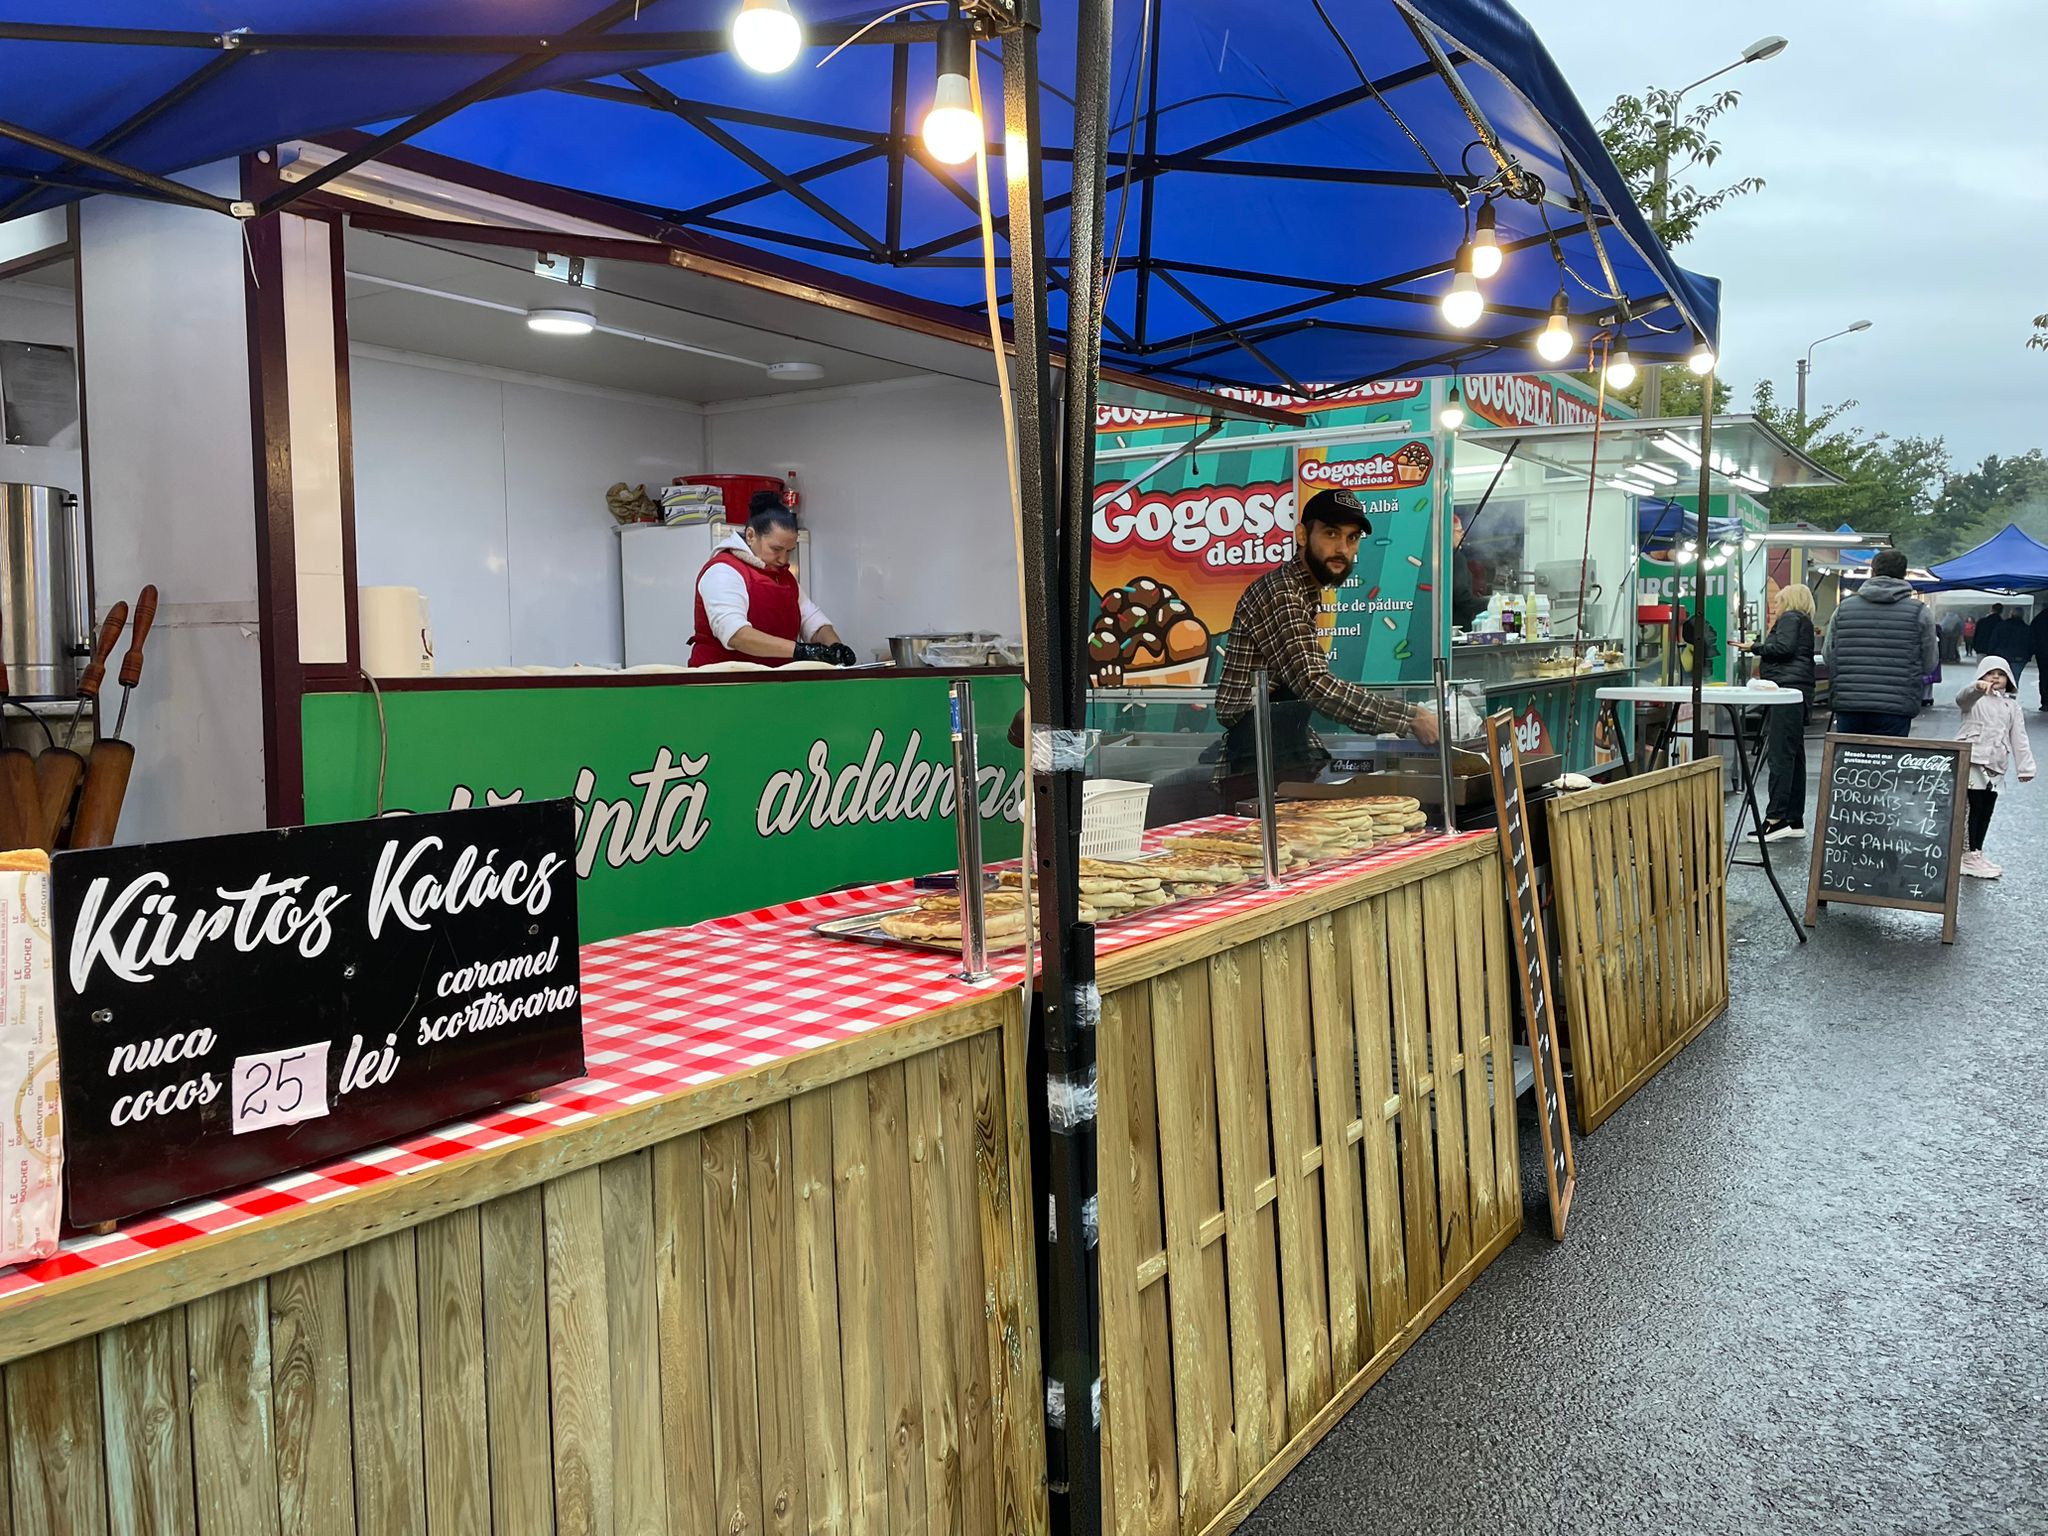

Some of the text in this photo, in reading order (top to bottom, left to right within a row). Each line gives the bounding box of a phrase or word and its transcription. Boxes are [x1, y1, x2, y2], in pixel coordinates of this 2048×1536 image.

[1302, 457, 1394, 482] Gogoșele
[1342, 475, 1394, 486] delicioase
[1369, 498, 1399, 513] Albă
[1316, 598, 1414, 613] ructe de pădure
[1315, 623, 1361, 636] aramel
[1924, 801, 1938, 818] 7
[1916, 817, 1939, 837] 12
[1860, 833, 1912, 855] PAHAR
[1922, 843, 1942, 859] 10
[1823, 870, 1856, 892] SUC
[1921, 862, 1938, 879] 10
[367, 836, 567, 940] Kalács
[24, 937, 32, 980] BOUCHER
[437, 936, 560, 998] caramel
[14, 968, 22, 981] LE
[108, 1027, 218, 1077] nuca
[339, 1033, 401, 1096] lei
[240, 1051, 307, 1120] 25
[110, 1078, 222, 1128] cocos
[36, 1095, 44, 1148] CHARCUTIER
[10, 1193, 19, 1205] LE
